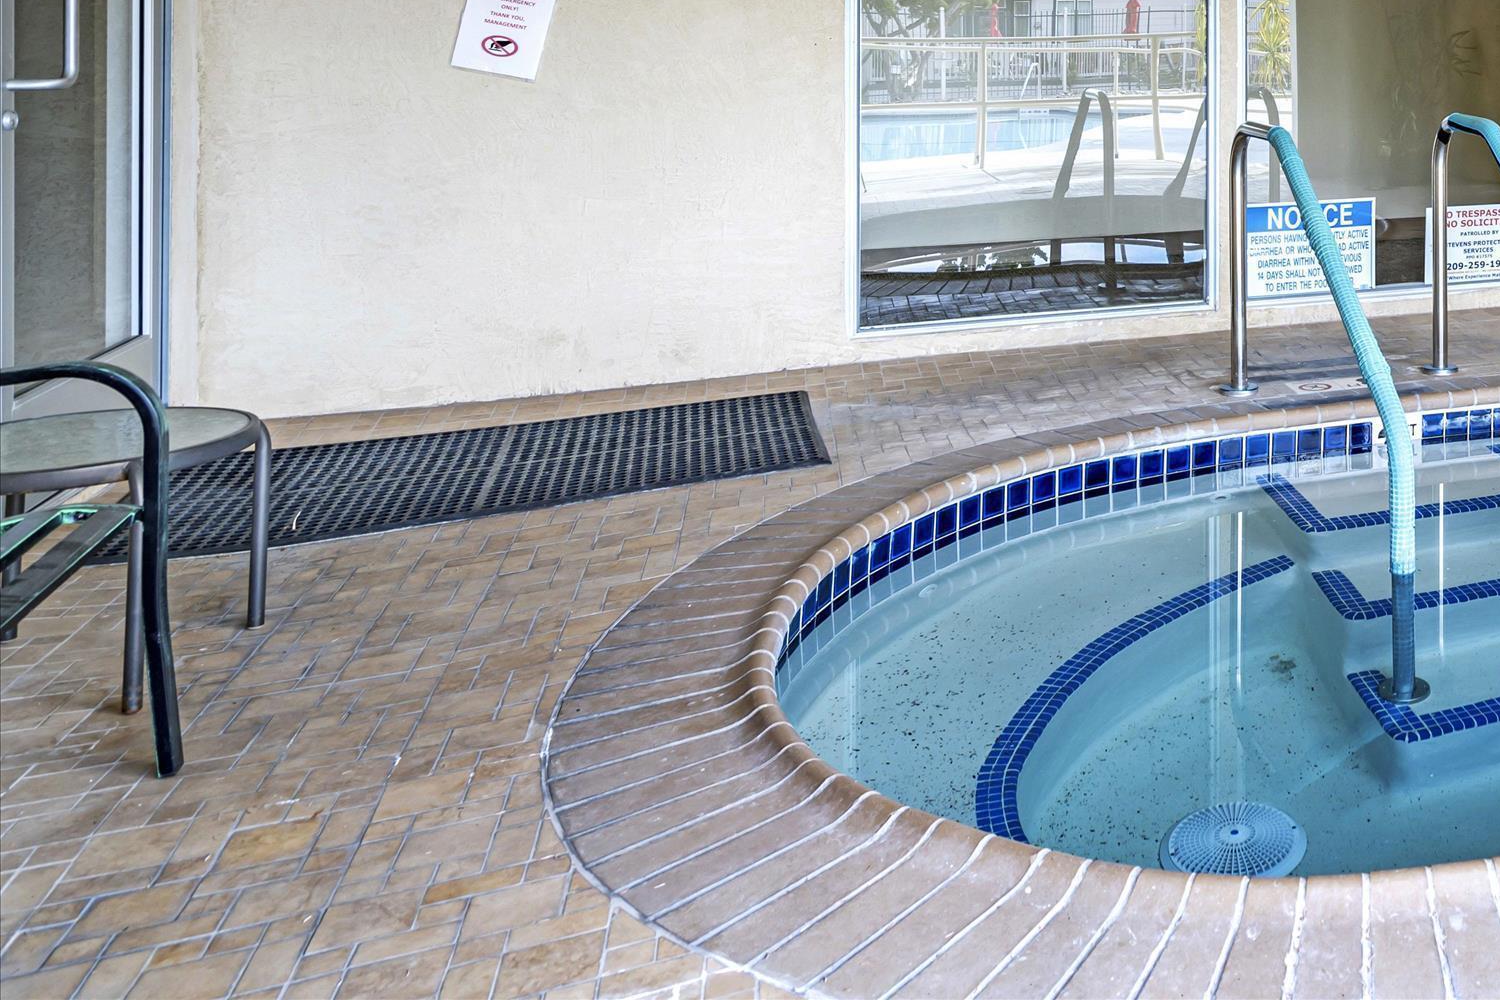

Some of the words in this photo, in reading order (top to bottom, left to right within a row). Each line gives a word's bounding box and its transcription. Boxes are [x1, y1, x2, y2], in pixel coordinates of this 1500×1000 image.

[490, 10, 510, 18] THANK
[484, 18, 527, 30] MANAGEMENT
[1267, 204, 1354, 230] NOCE
[1251, 235, 1281, 245] PERSONS
[1348, 229, 1368, 239] ACTIVE
[1285, 246, 1295, 255] OR
[1348, 241, 1369, 250] ACTIVE
[1257, 258, 1291, 269] DIARRHEA
[1293, 256, 1315, 266] WITHIN
[1258, 272, 1264, 280] 14
[1267, 270, 1283, 280] DAYS
[1285, 269, 1306, 279] SHALL
[1308, 268, 1321, 277] NOT
[1265, 282, 1274, 292] TO
[1276, 281, 1297, 292] ENTER
[1300, 280, 1312, 290] THE
[1314, 279, 1328, 289] POO
